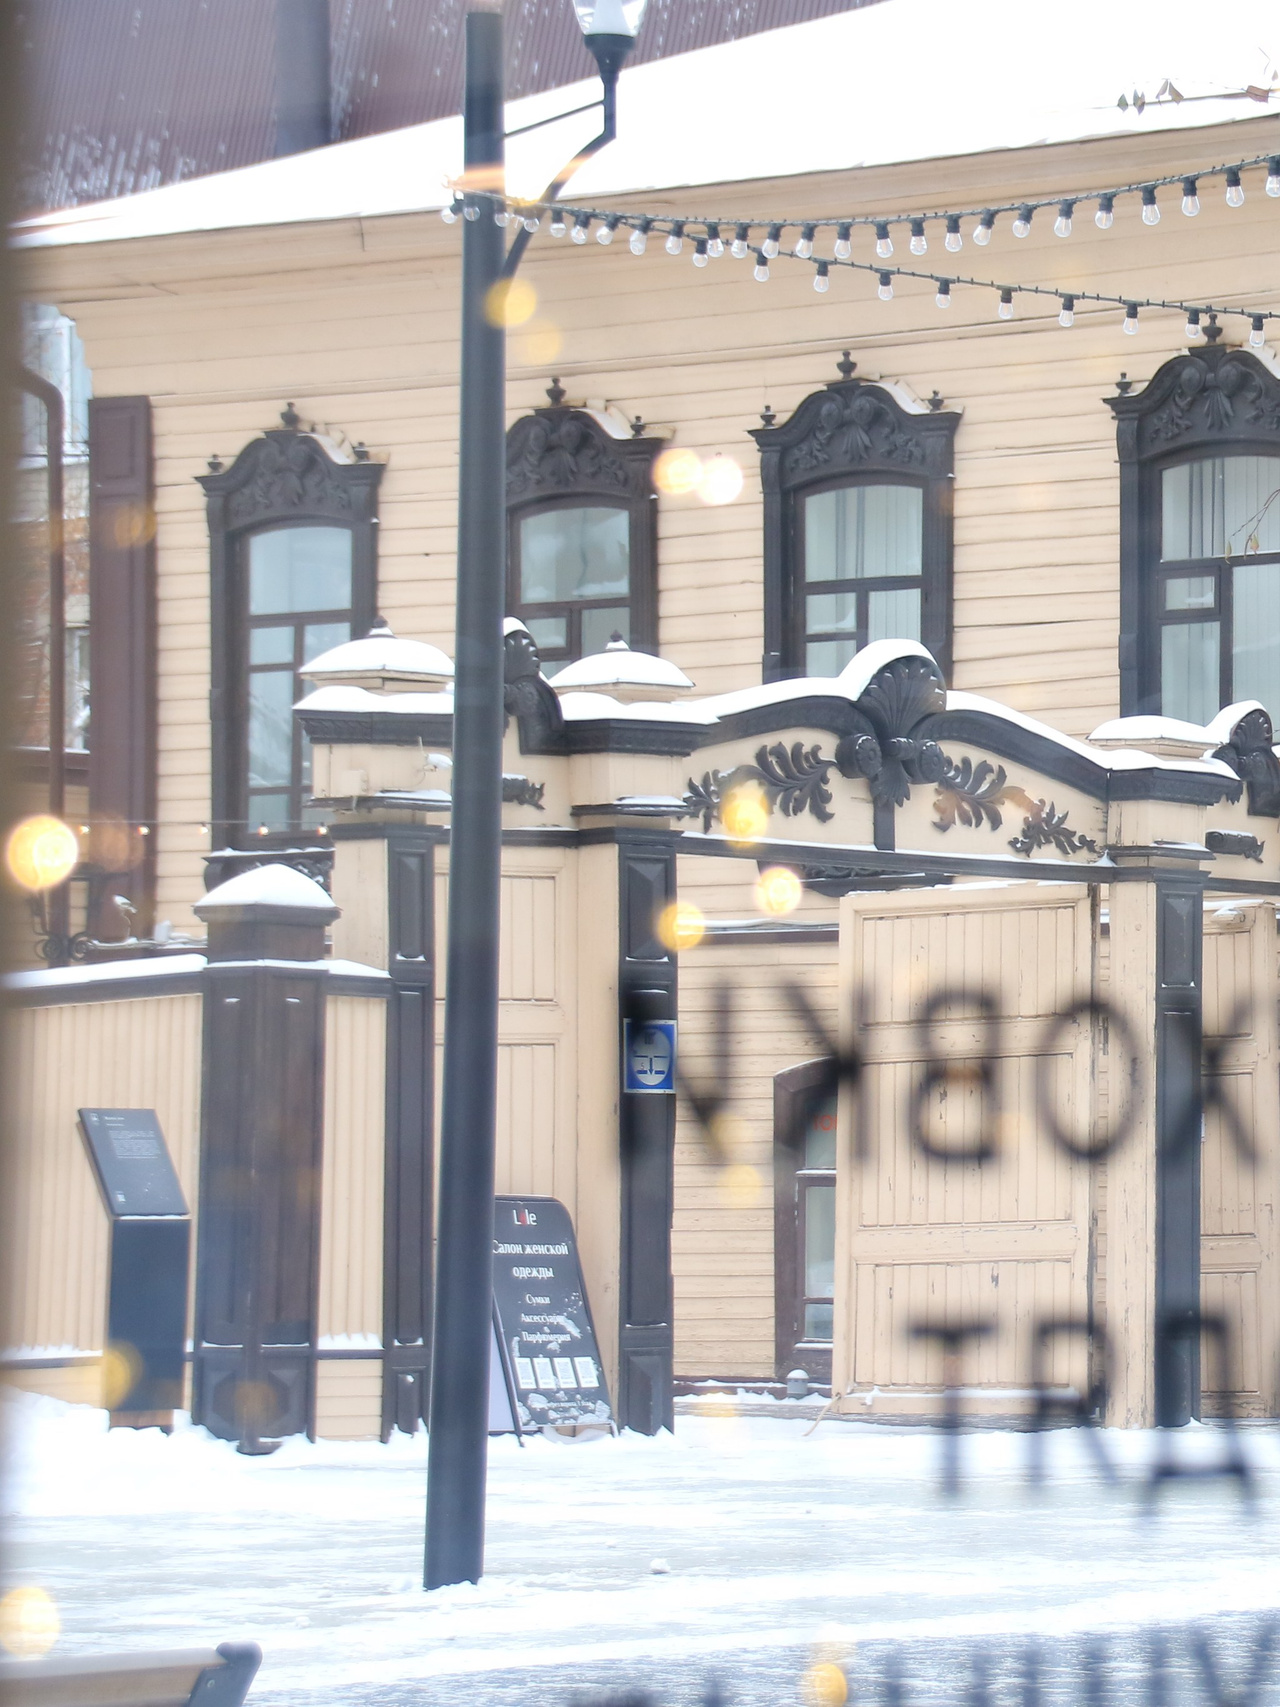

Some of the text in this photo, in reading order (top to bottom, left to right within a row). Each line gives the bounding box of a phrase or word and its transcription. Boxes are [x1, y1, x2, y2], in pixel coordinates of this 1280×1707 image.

[524, 1241, 569, 1255] женской
[512, 1265, 555, 1279] одежды
[526, 1294, 551, 1306] Сумки
[522, 1332, 572, 1343] Парфюмерия
